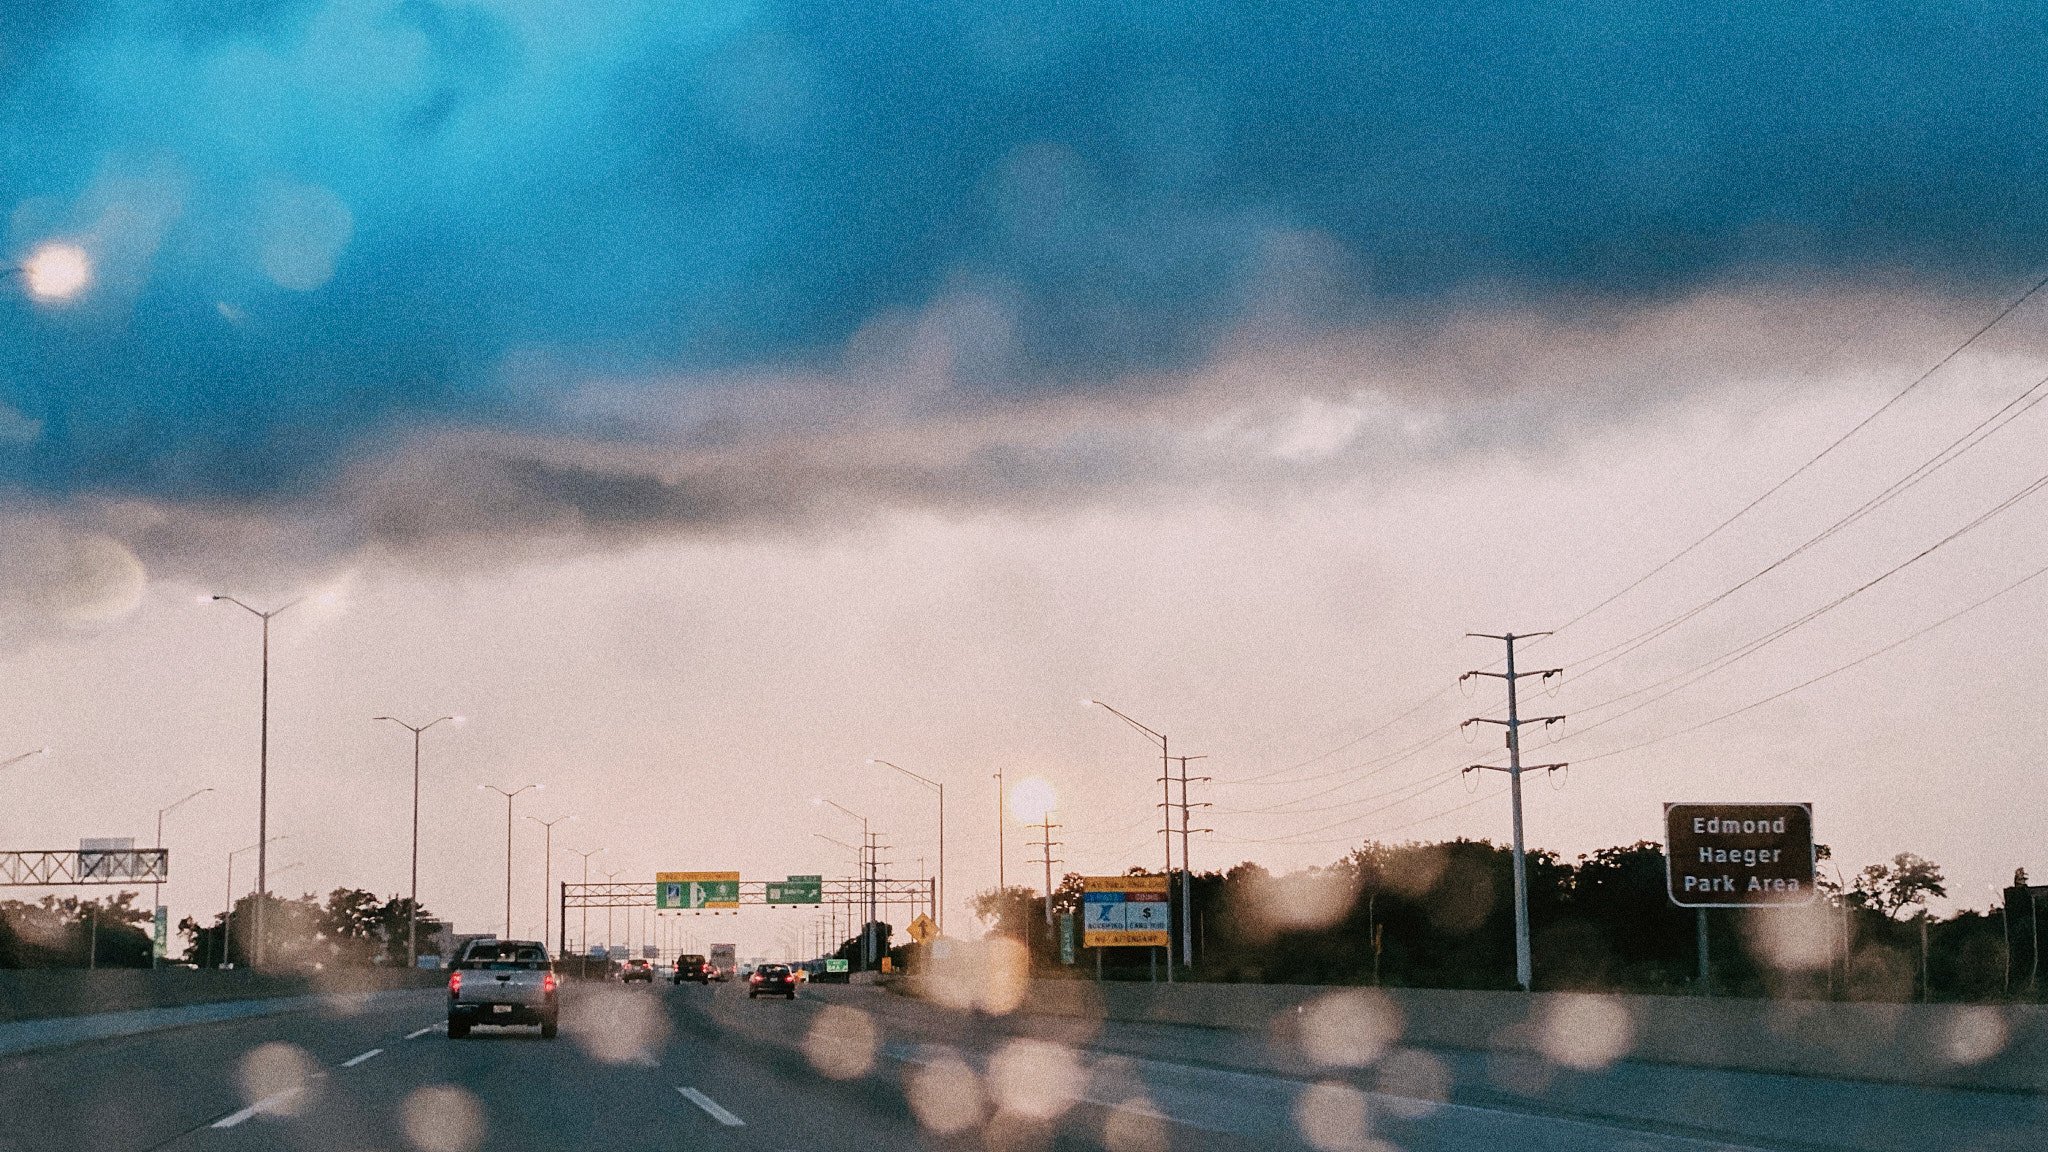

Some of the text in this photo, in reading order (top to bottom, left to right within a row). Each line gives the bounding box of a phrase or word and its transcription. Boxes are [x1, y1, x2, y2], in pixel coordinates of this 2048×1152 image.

[1693, 816, 1785, 834] Edmond
[1699, 847, 1781, 867] Haeger
[1684, 874, 1800, 892] Park Area
